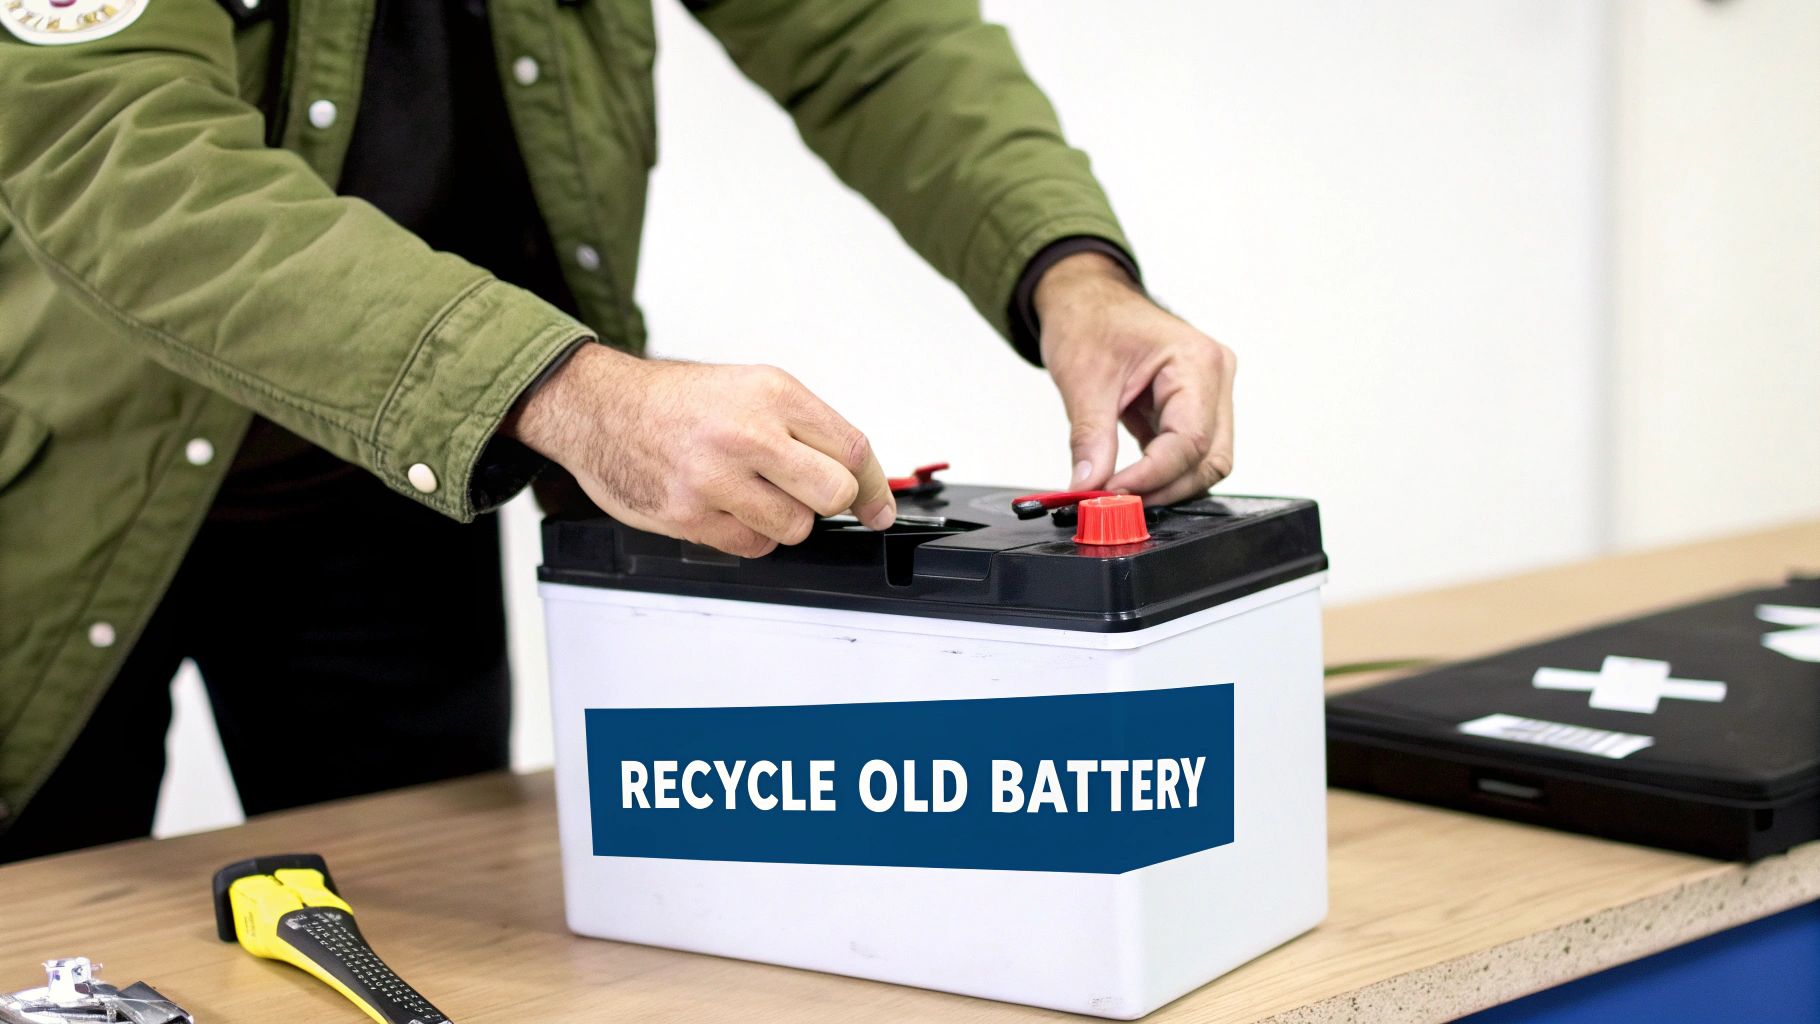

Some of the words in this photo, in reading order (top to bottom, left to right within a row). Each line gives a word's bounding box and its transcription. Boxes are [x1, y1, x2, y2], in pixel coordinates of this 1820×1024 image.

[622, 760, 836, 812] RECYCLE
[859, 760, 967, 813] OLD
[992, 757, 1206, 813] BATTERY
